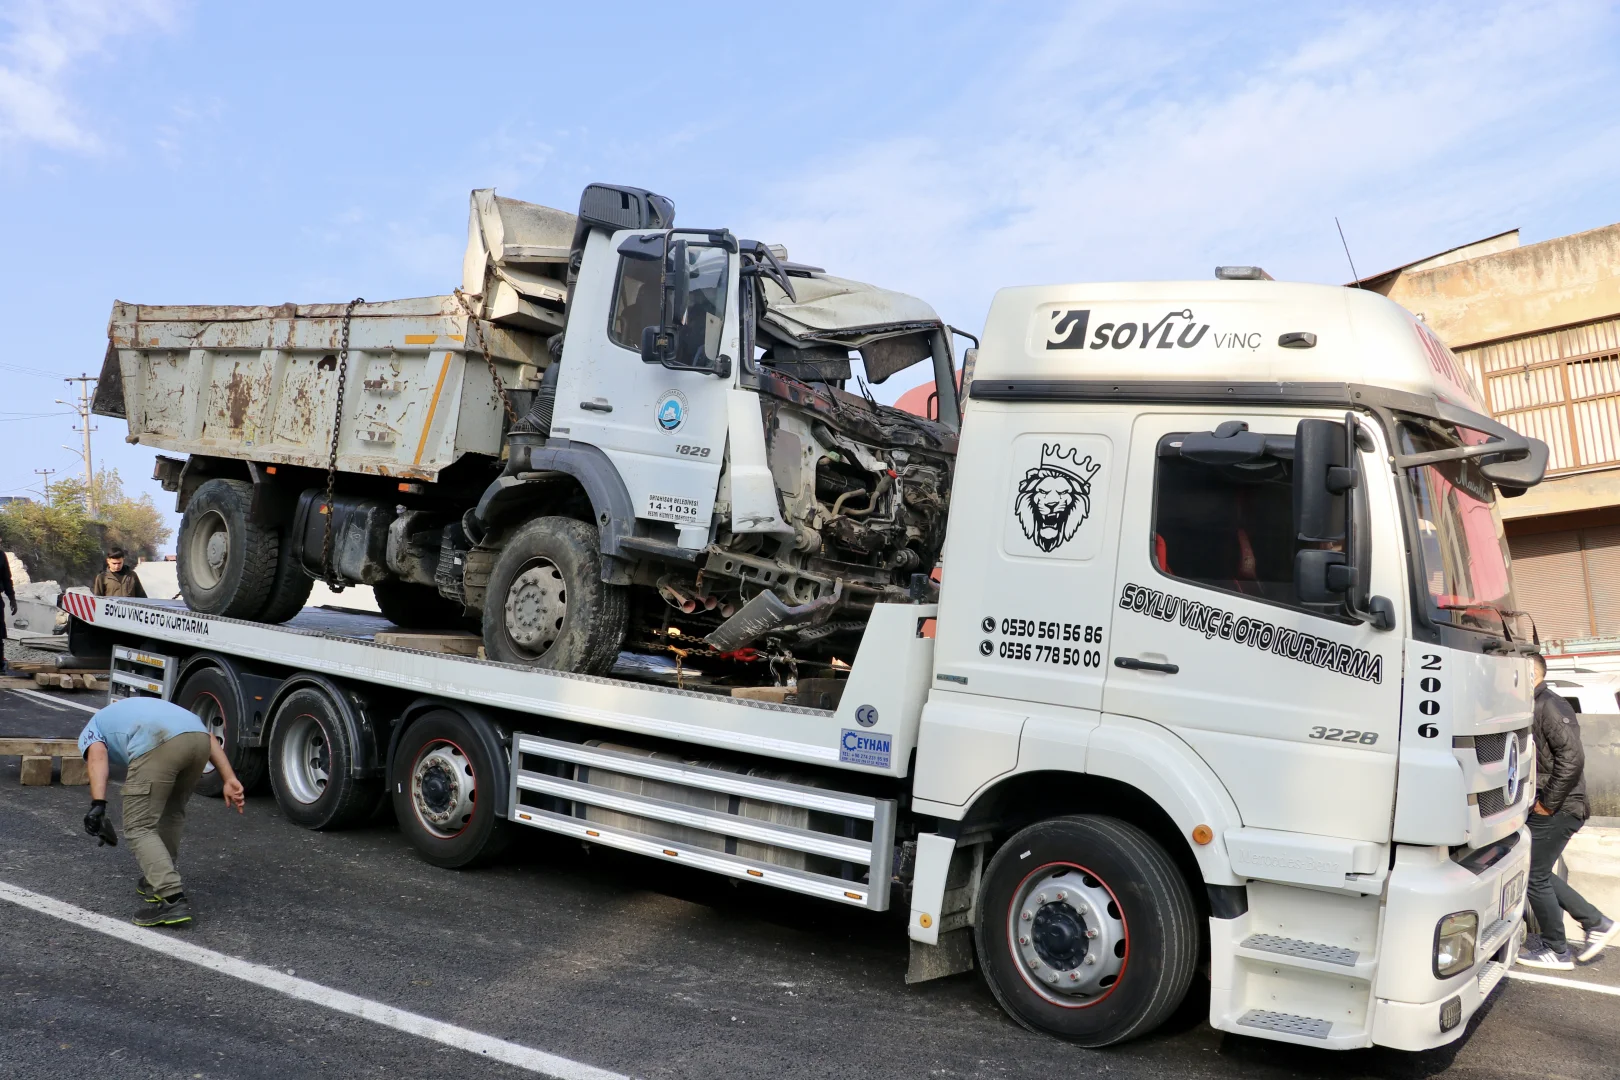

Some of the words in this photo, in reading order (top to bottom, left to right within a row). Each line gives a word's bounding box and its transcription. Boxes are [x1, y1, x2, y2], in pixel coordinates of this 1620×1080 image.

[1089, 309, 1210, 350] SOYLU
[676, 445, 711, 458] 1829
[649, 502, 697, 515] 14-1036
[104, 603, 126, 619] SOYLU
[150, 613, 165, 627] OTO
[165, 616, 209, 636] KURTARMA
[1001, 618, 1035, 638] 0530
[1038, 621, 1060, 640] 561
[1063, 623, 1081, 642] 56
[1084, 625, 1103, 644] 86
[1119, 583, 1180, 622] SOYLU
[1218, 612, 1235, 640] &
[1233, 616, 1275, 651] OTO
[1272, 626, 1383, 685] KURTARMA
[999, 641, 1032, 661] 0536
[1035, 645, 1060, 664] 778
[1062, 648, 1080, 666] 50
[1083, 650, 1101, 668] 00
[1418, 654, 1442, 739] 2006
[857, 708, 875, 724] CE
[843, 732, 889, 752] CEYHAN
[1308, 726, 1379, 746] 3228
